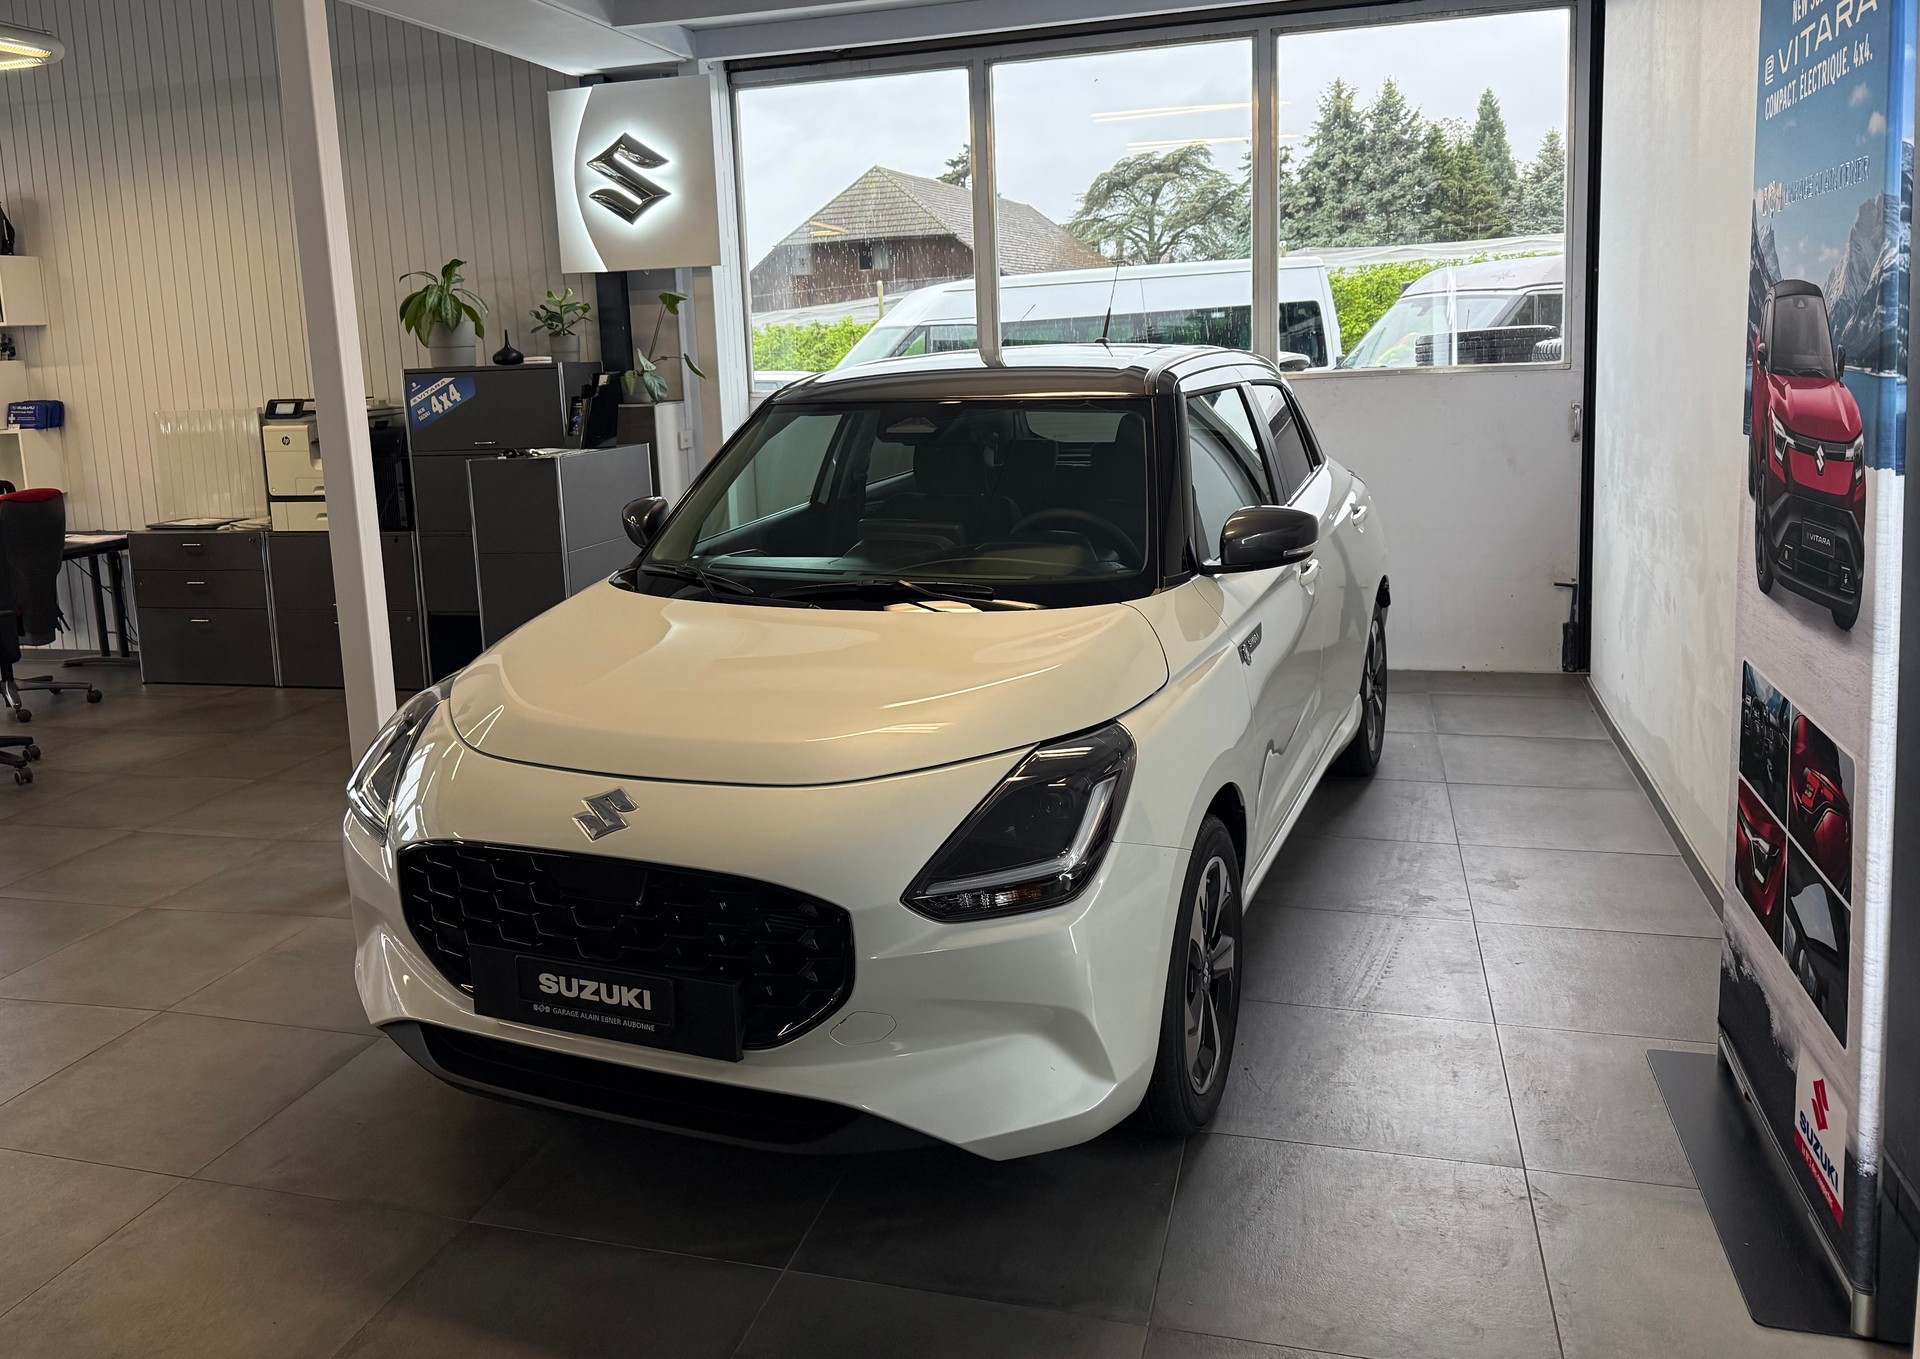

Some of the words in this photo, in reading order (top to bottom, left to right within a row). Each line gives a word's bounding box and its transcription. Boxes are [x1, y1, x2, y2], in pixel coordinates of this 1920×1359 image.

[1764, 79, 1798, 121] COMPACT.
[1800, 46, 1850, 101] ÉLECTRIQUE.
[538, 972, 652, 1011] SUZUKI
[552, 1007, 579, 1018] GARAGE
[580, 1012, 600, 1022] ALAIN
[601, 1015, 622, 1026] EBNER
[622, 1020, 655, 1032] AUBONNE
[1799, 1110, 1839, 1194] SUZUKI
